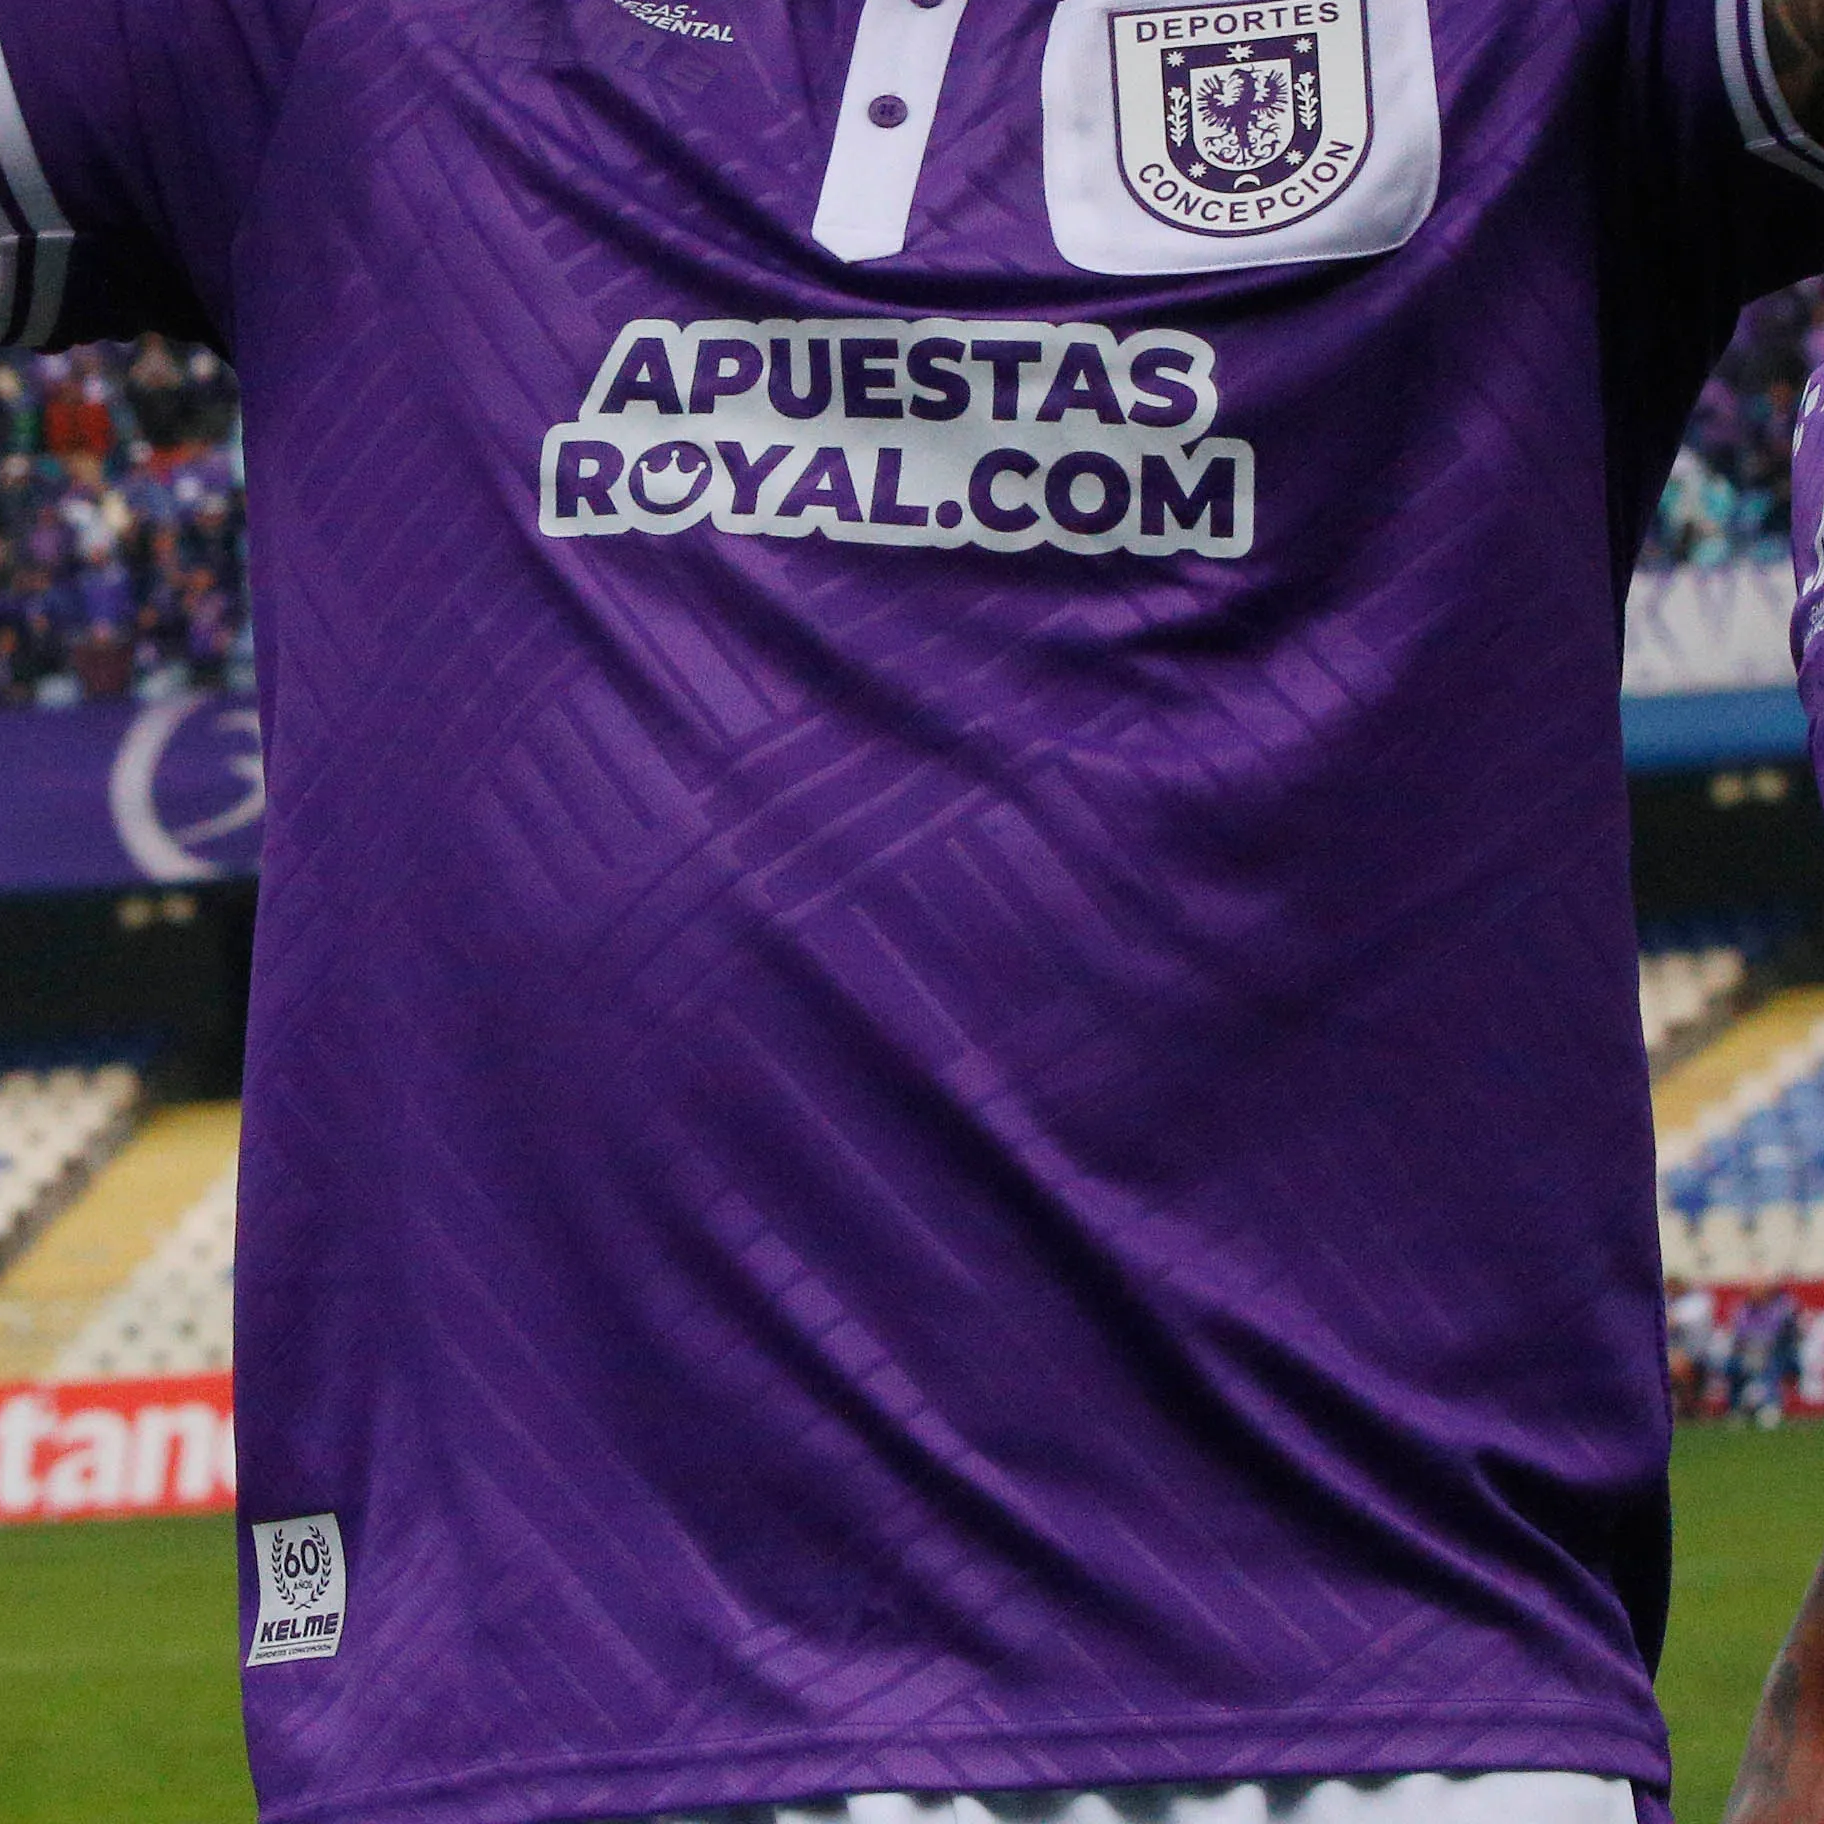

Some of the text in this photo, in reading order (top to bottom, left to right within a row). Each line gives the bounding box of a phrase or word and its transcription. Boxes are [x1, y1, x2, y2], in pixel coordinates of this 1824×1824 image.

[1136, 2, 1340, 43] DEPORTES
[1138, 139, 1355, 224] CONCEPCION
[598, 336, 1198, 428] APUESTAS
[554, 439, 1236, 539] ROYAL.COM
[284, 1539, 320, 1578] 60
[260, 1612, 340, 1643] KELME
